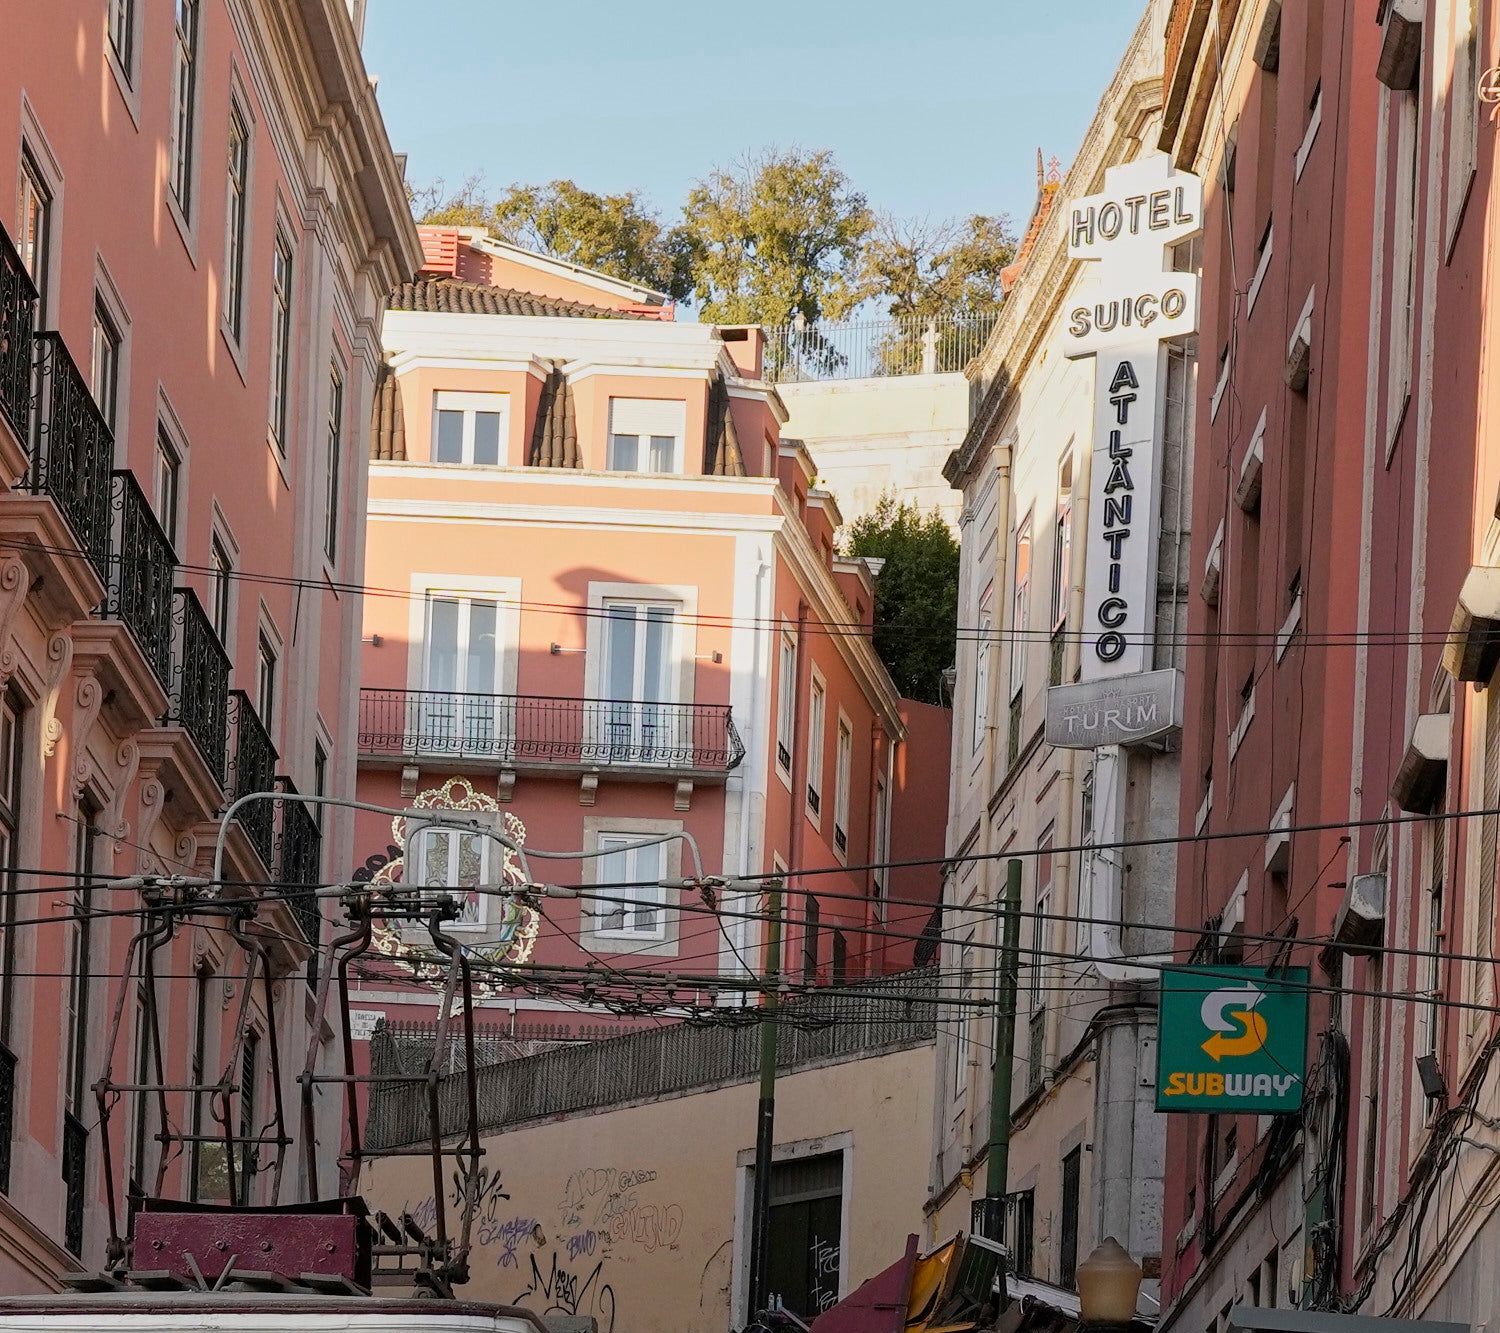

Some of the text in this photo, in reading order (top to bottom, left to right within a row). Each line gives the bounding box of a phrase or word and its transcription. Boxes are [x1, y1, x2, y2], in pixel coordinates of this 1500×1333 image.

[1071, 186, 1193, 248] HOTEL
[1069, 289, 1186, 338] SUIÇO
[1096, 361, 1139, 663] ATLÂNTICO
[1063, 703, 1157, 732] TURIM
[1163, 1072, 1300, 1097] SUBWAY
